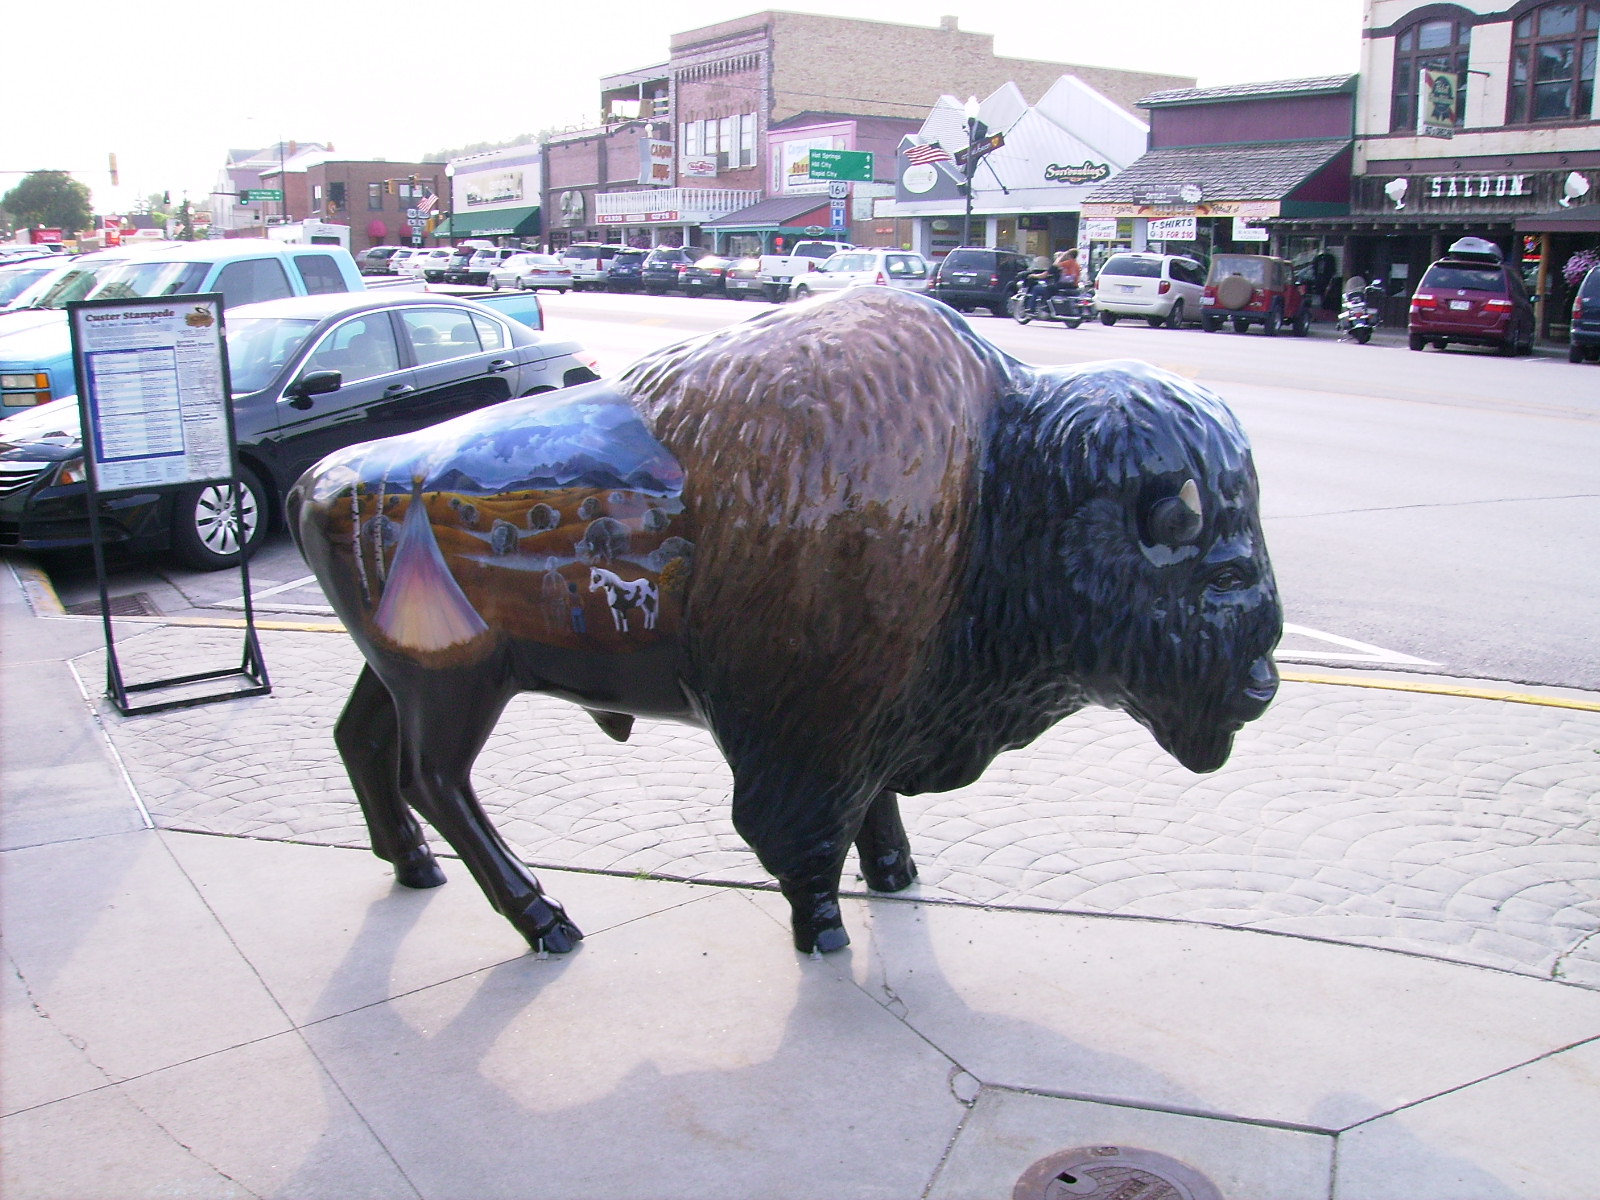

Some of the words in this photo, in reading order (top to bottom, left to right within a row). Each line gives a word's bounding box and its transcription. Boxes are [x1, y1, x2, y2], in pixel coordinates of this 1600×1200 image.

[821, 161, 832, 169] City
[827, 171, 838, 179] City
[1431, 174, 1525, 198] SALOON
[1151, 218, 1193, 230] T-SHIRTS
[1167, 230, 1179, 238] FOR
[85, 313, 121, 322] Custer
[122, 309, 176, 321] Stampede
